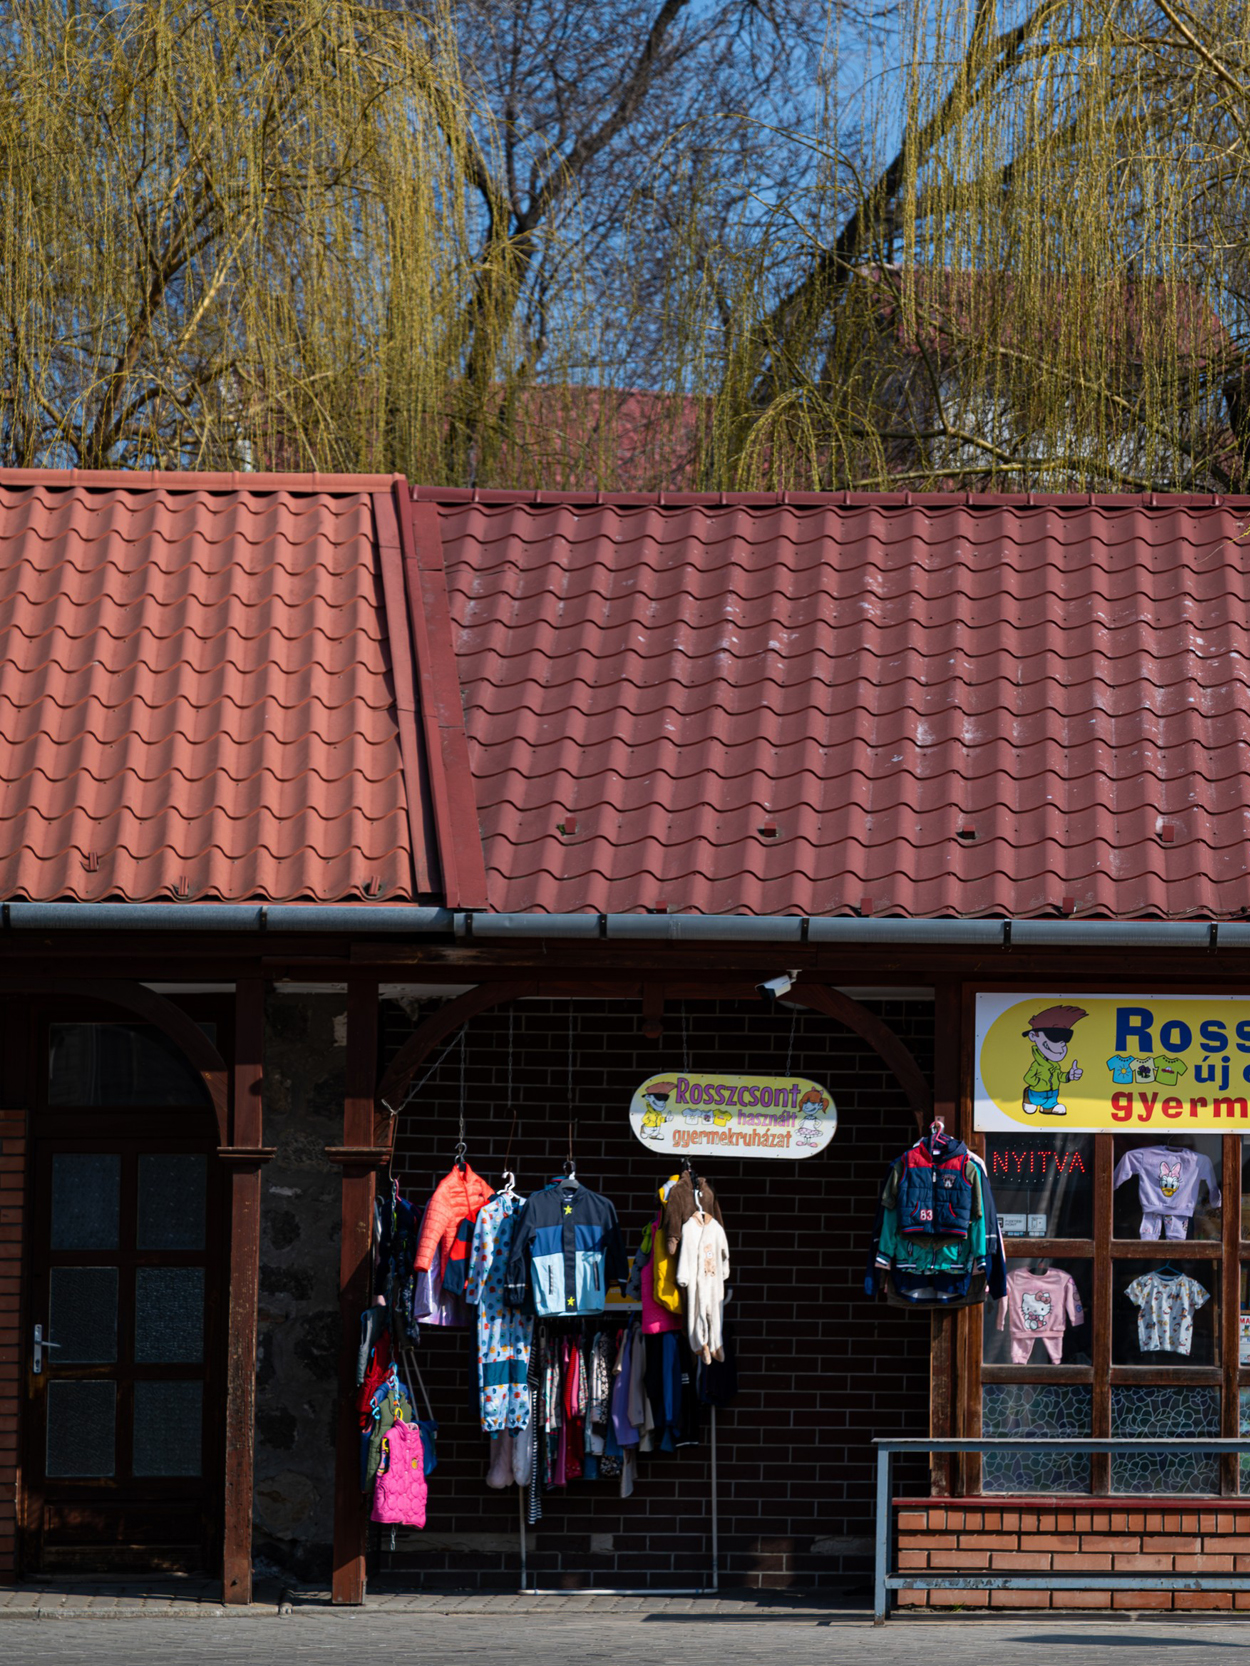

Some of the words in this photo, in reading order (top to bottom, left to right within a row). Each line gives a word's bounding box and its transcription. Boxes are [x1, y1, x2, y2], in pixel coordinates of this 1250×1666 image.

[1194, 1055, 1231, 1091] új
[674, 1077, 801, 1108] Rosszcsont
[736, 1109, 798, 1128] használt
[672, 1128, 792, 1148] gyermekruházat
[993, 1151, 1085, 1173] NYITVA
[920, 1209, 933, 1221] 83
